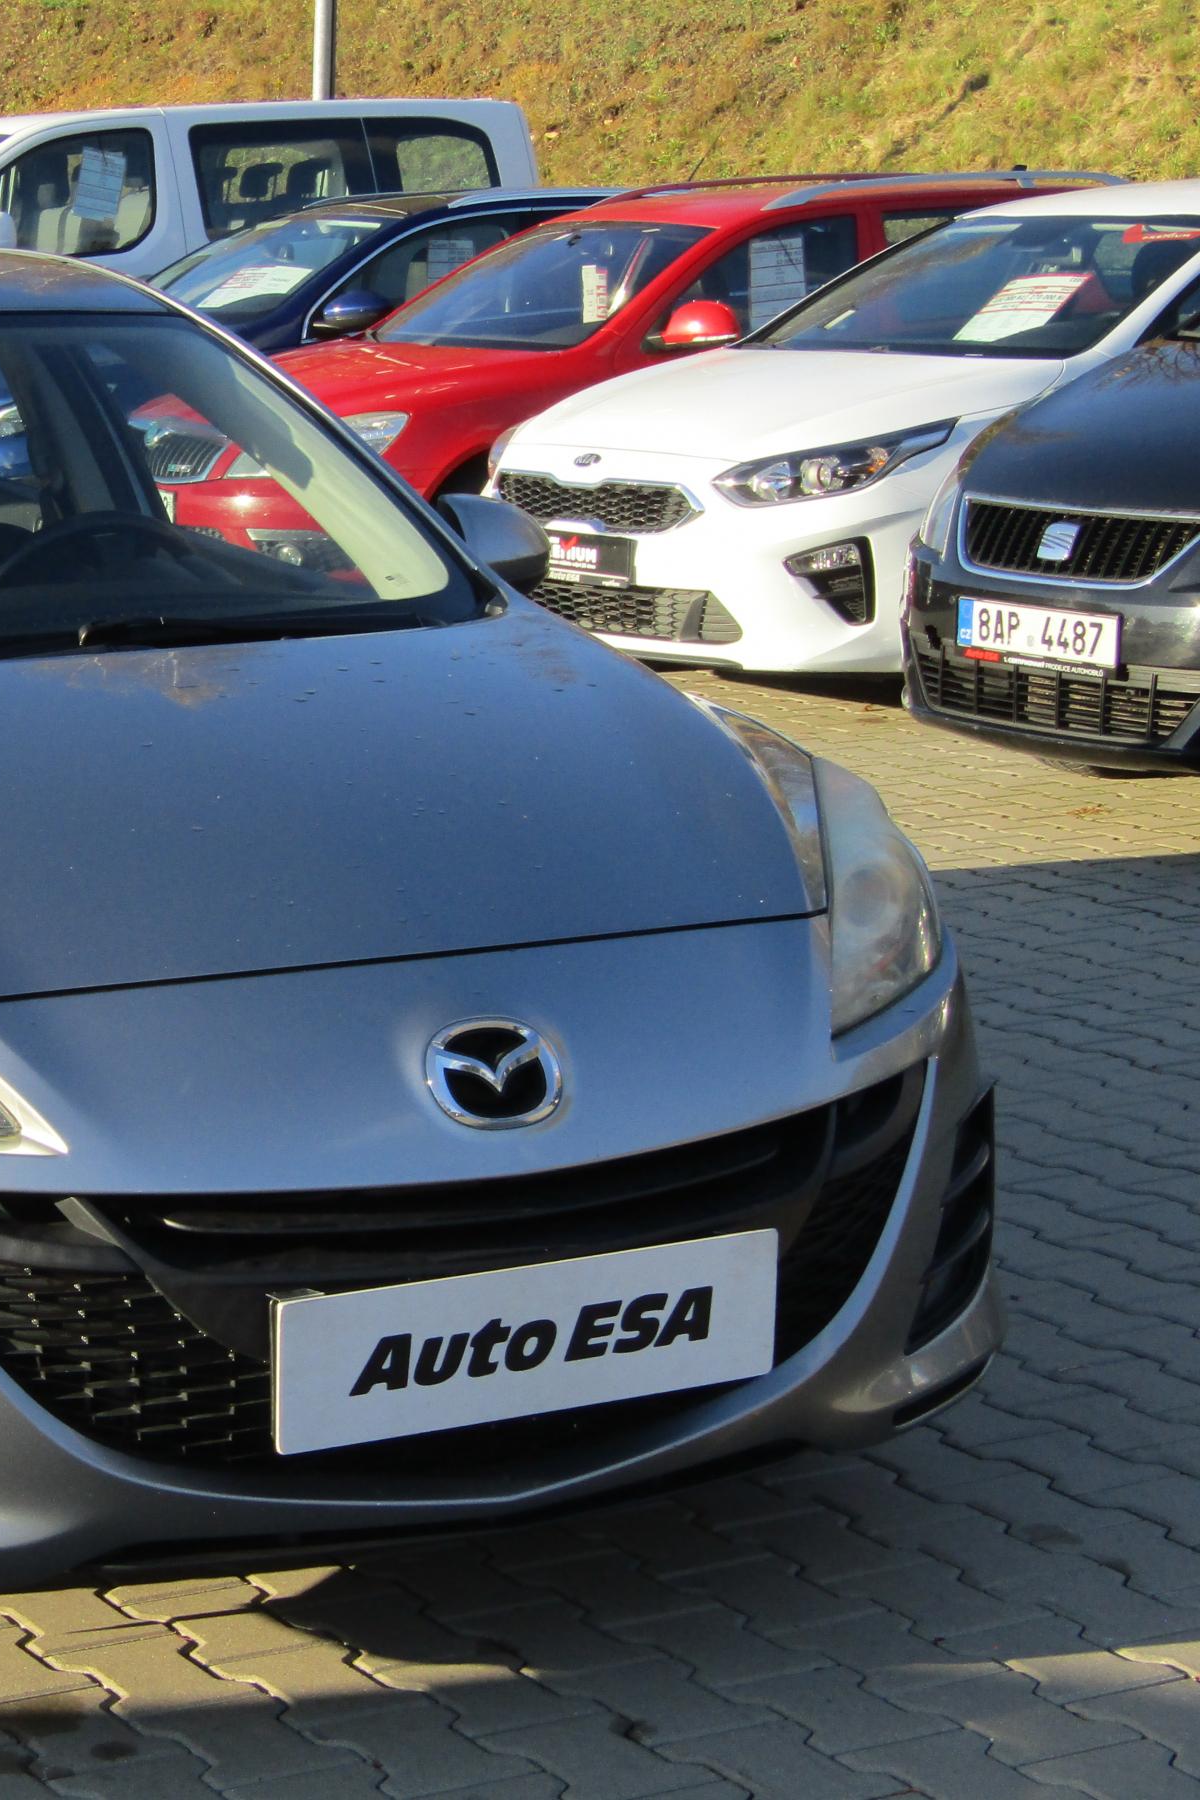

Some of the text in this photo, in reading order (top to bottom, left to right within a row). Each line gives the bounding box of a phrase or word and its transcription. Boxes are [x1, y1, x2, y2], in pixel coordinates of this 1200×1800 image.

[960, 628, 971, 639] CZ
[979, 608, 1103, 656] 8AP 4487
[349, 1285, 713, 1396] Auto ESA
